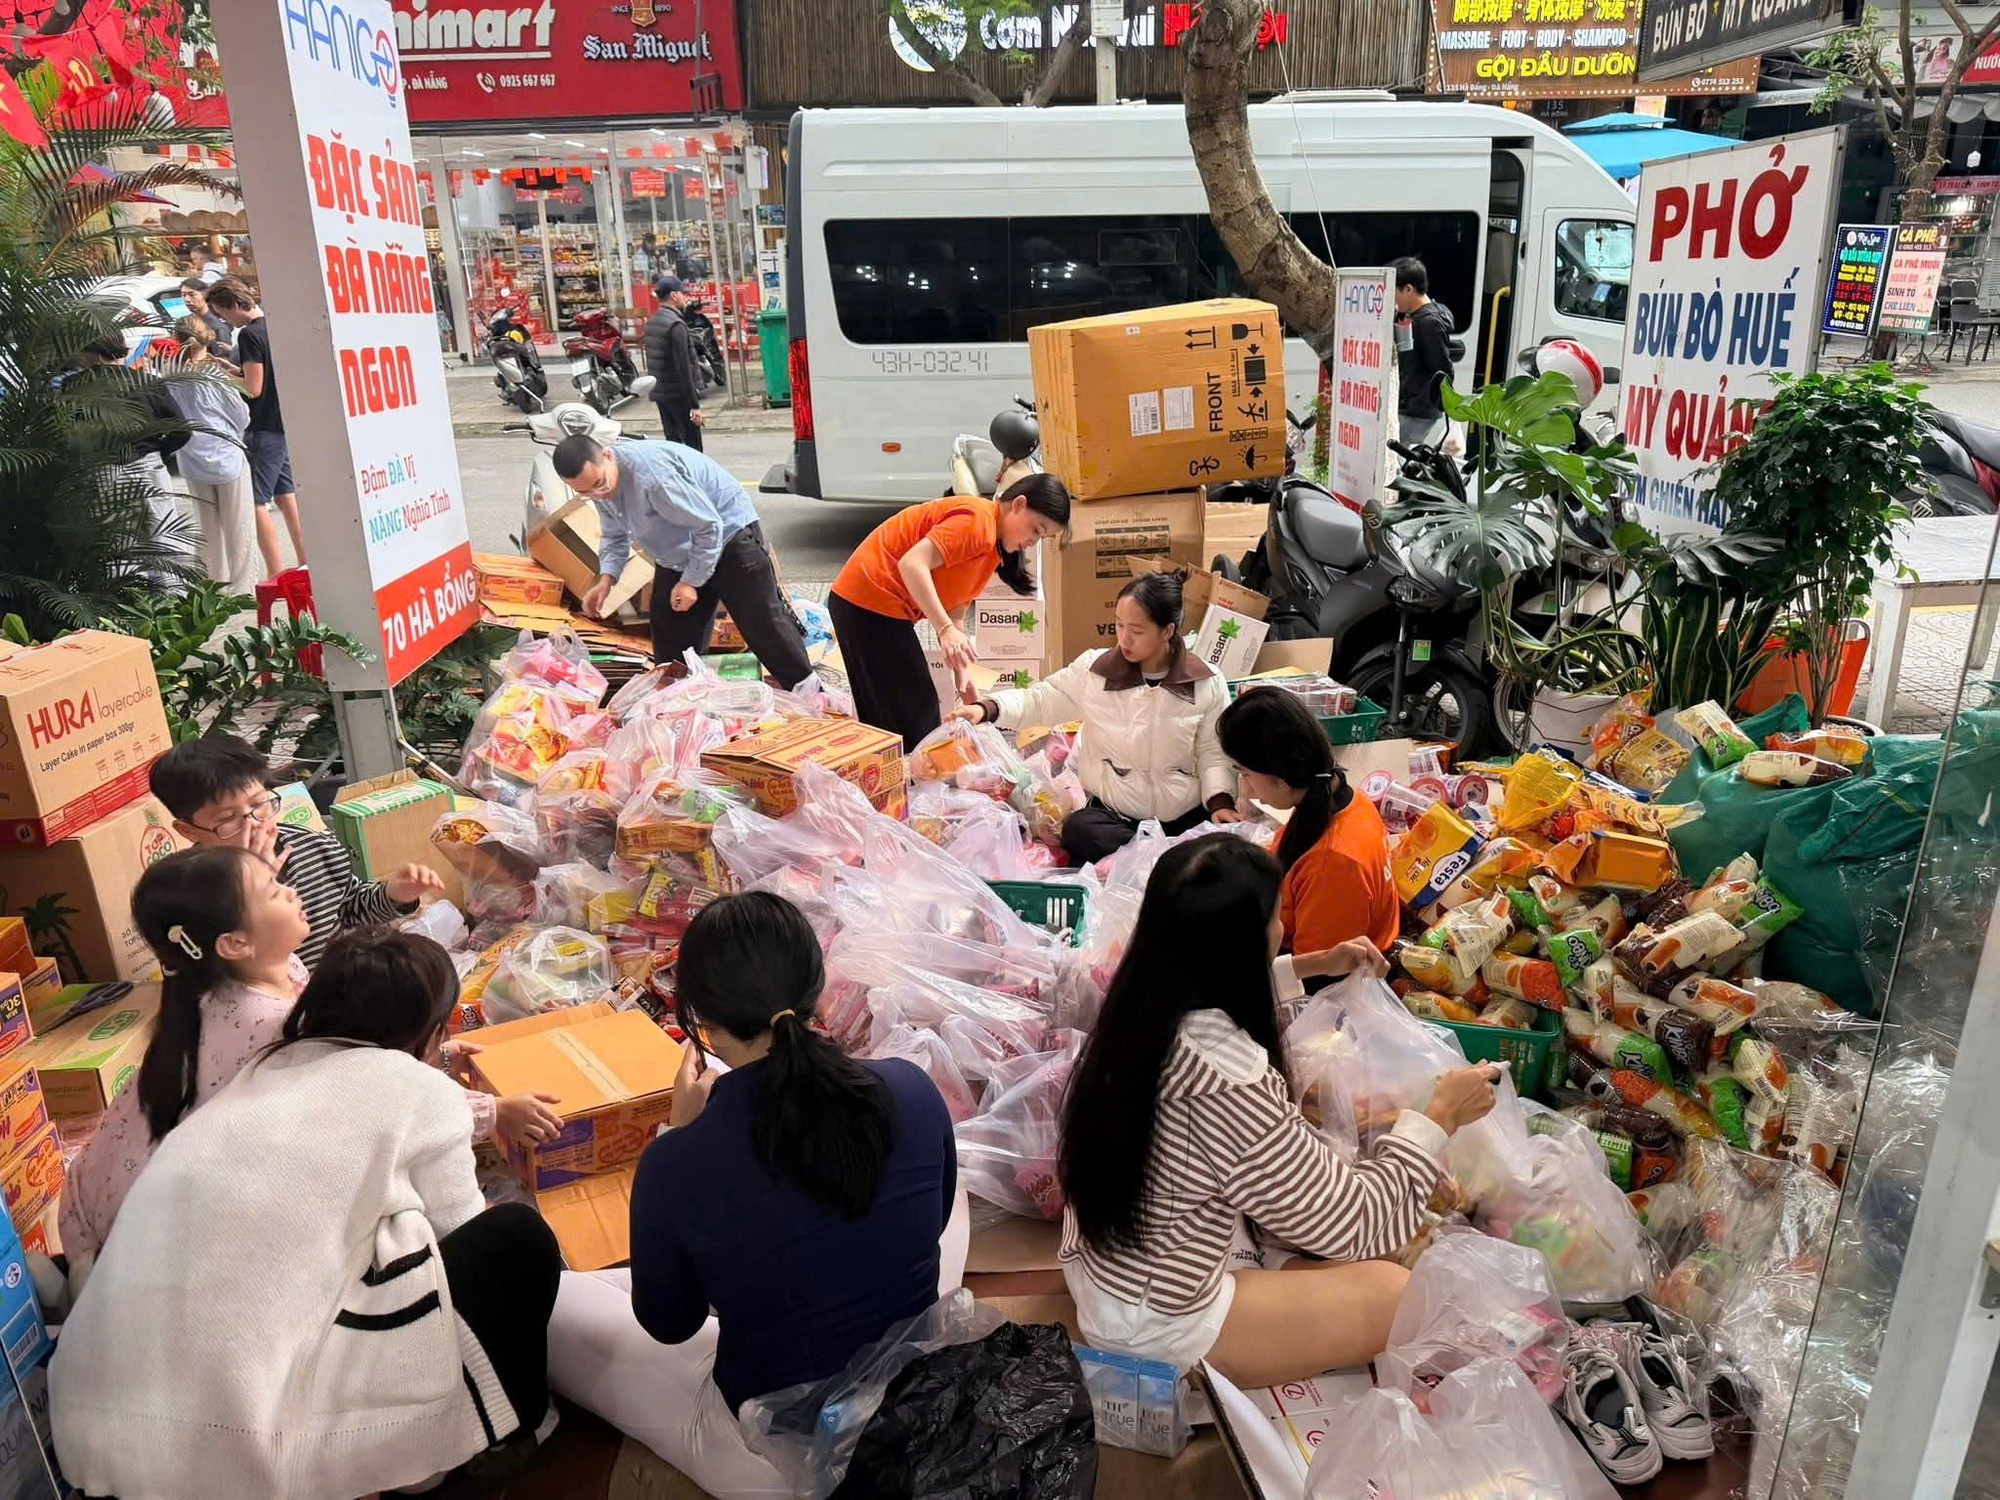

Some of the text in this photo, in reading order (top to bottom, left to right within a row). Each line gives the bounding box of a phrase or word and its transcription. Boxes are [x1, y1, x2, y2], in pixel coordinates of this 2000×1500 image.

[583, 33, 628, 61] San
[1440, 28, 1626, 49] MASSAGE FOOT BODY SHAMPOO
[500, 73, 556, 87] 0925 667 667
[1476, 50, 1637, 81] GỘI ĐẦU DƯỠN
[307, 129, 421, 227] ĐẶC SẢN
[1649, 144, 1810, 262] PHỞ
[324, 236, 434, 314] ĐÀ NẴNG
[1633, 267, 1801, 368] BÚN BÒ HUẾ
[872, 351, 988, 373] 43H-032.41
[1342, 333, 1381, 368] ĐẶC SẢN
[339, 345, 418, 418] NGON
[1206, 372, 1223, 432] FRONT
[1340, 377, 1378, 413] ĐÀ NẴNG
[1624, 374, 1663, 449] MỲ
[1338, 420, 1361, 451] NGON
[361, 453, 418, 499] Đậm ĐÀ Vị
[401, 500, 431, 532] Nghĩa
[430, 488, 452, 516] Tình
[382, 560, 477, 660] 70 HÀ BỔNG
[980, 612, 1023, 624] Dasani
[26, 668, 154, 750] HURA layercake
[40, 754, 62, 773] Layer
[61, 748, 79, 763] Cake
[79, 744, 87, 753] in
[86, 735, 105, 752] paper
[105, 729, 118, 742] box
[145, 833, 165, 854] TOP
[1434, 855, 1468, 886] Festa
